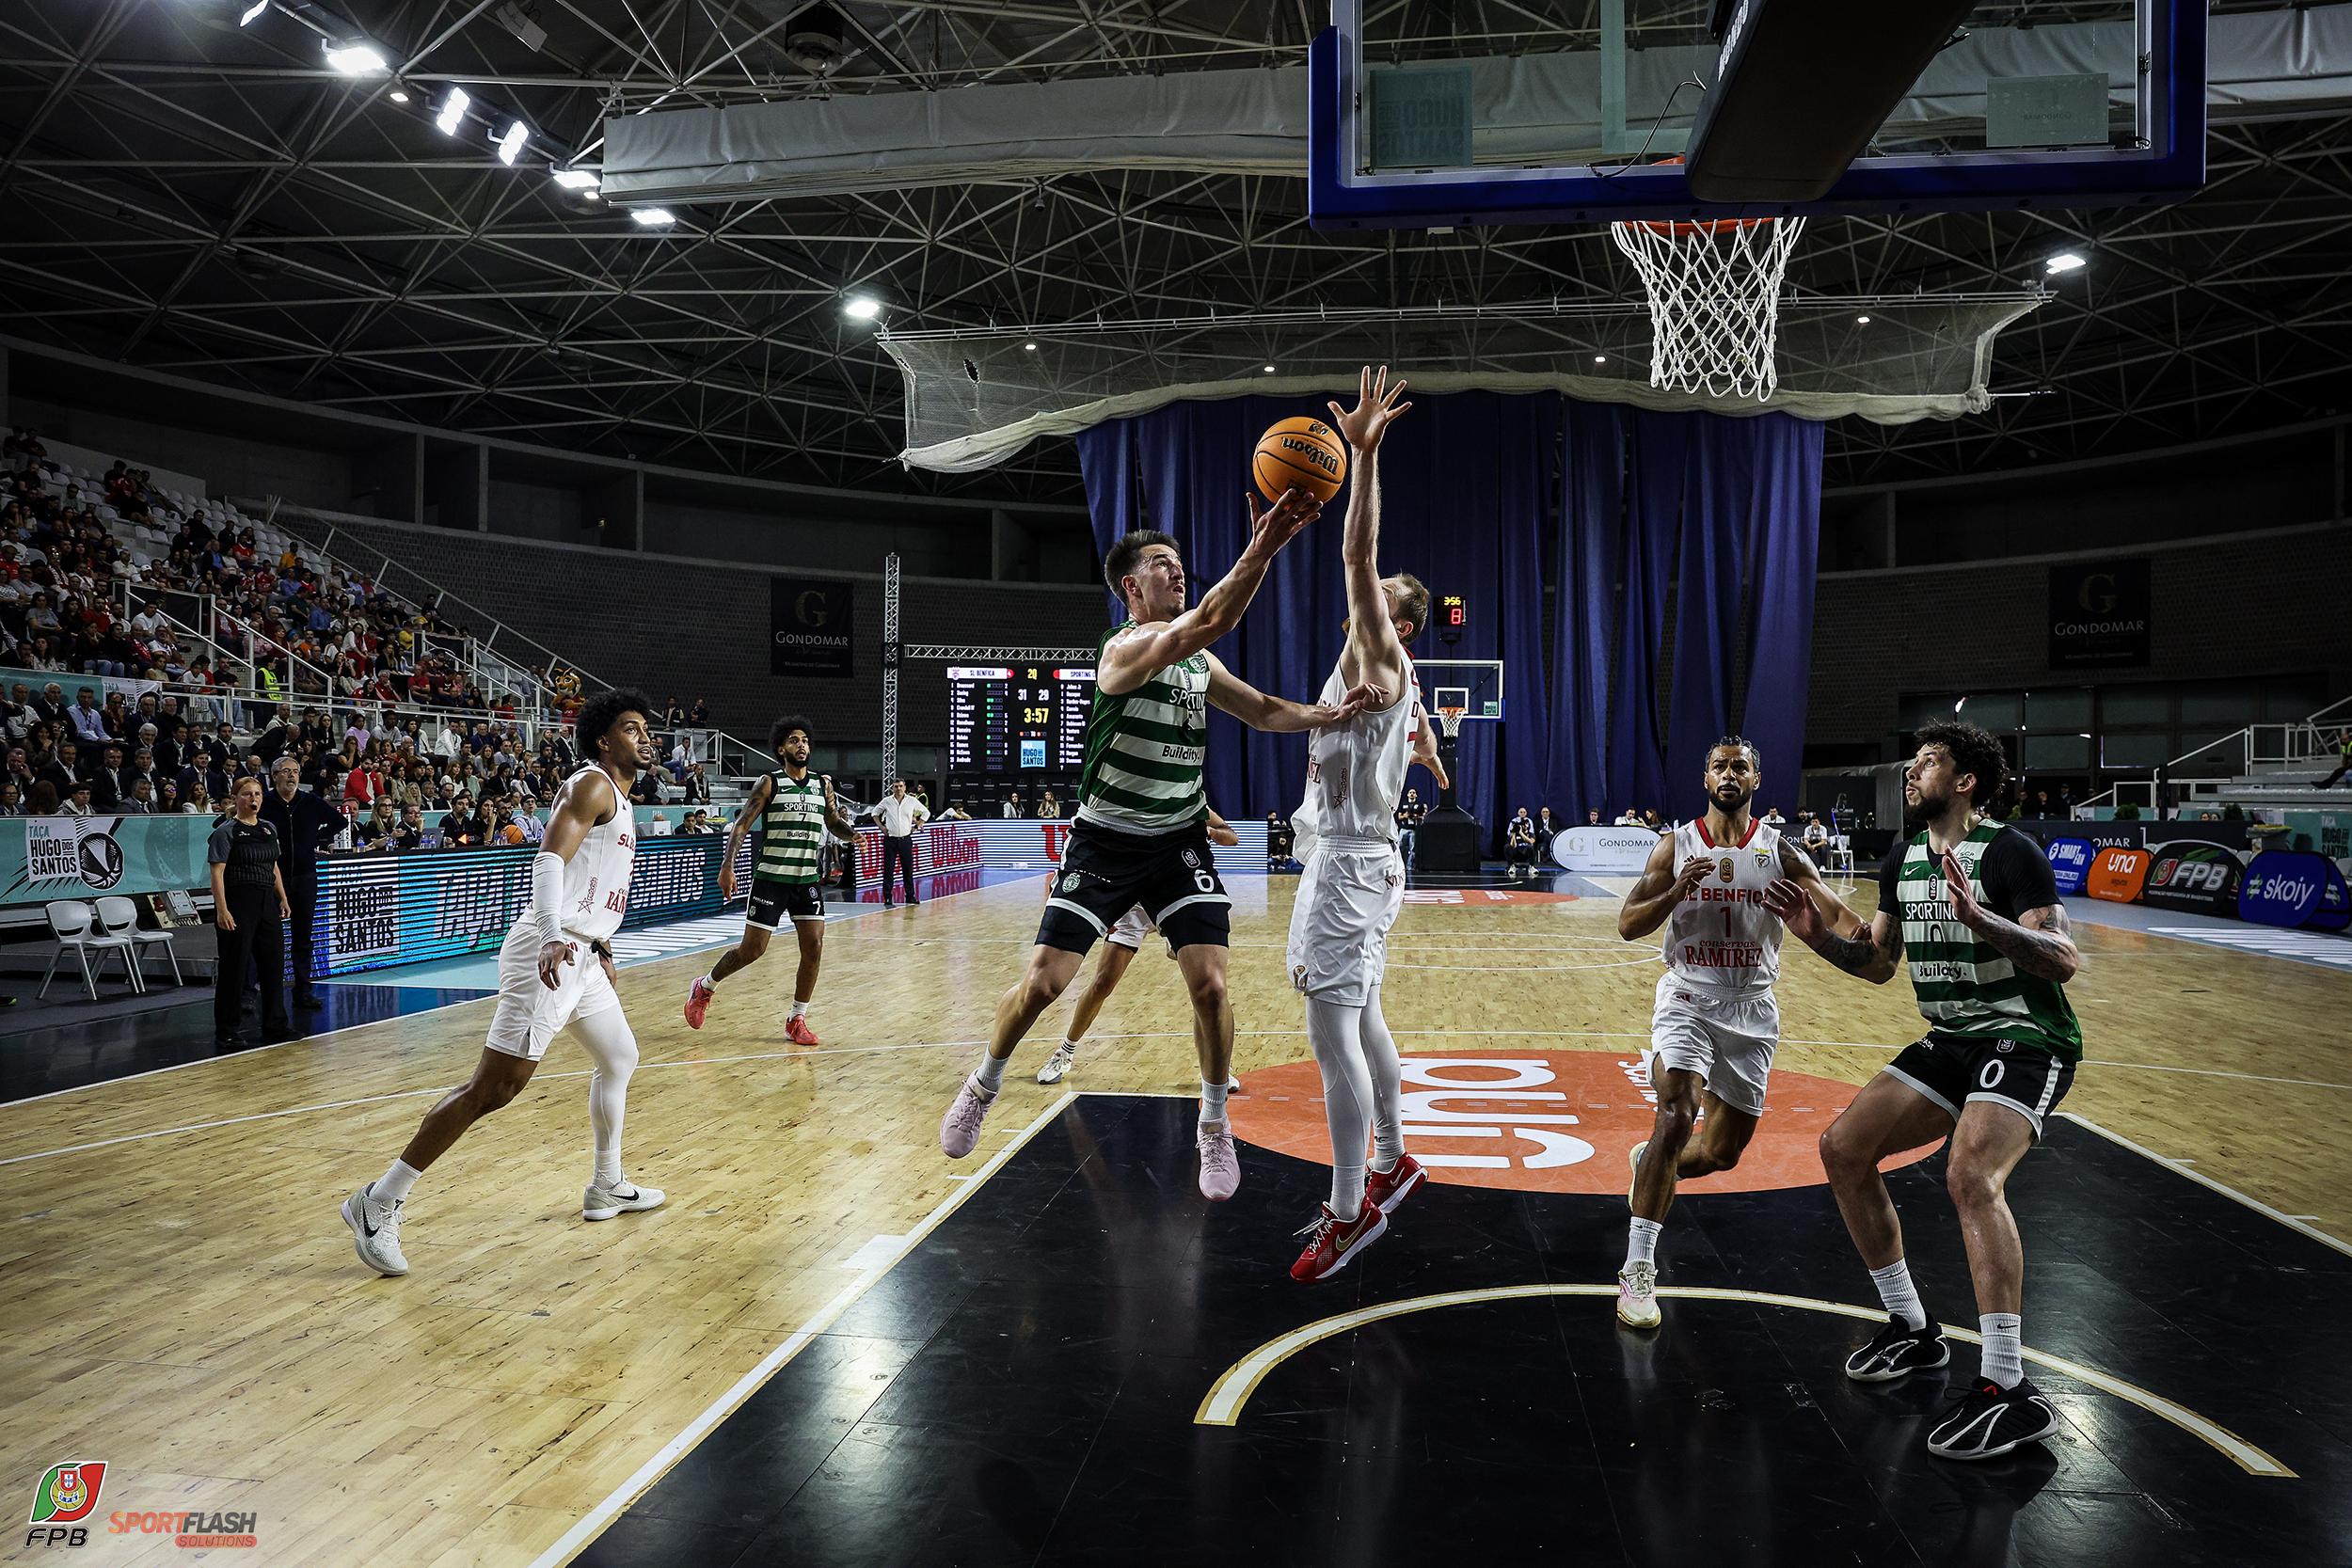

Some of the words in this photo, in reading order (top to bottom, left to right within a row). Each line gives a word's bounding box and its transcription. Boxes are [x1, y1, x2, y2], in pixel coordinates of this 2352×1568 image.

[1281, 436, 1339, 476] Wilson
[1451, 609, 1462, 625] 8
[2055, 620, 2145, 636] GONDOMAR
[775, 631, 849, 647] GONDOMAR
[1018, 689, 1027, 701] 31
[1038, 689, 1050, 701] 29
[1168, 688, 1206, 711] SPTIN
[1024, 707, 1050, 723] 3:57
[784, 802, 818, 813] SPORTING
[798, 813, 807, 823] 7
[29, 825, 50, 838] TAÇA
[30, 838, 61, 858] HUGO
[62, 842, 74, 851] DOS
[1598, 838, 1655, 847] GONDOMAR
[32, 857, 77, 876] SANTOS
[2107, 852, 2137, 874] una
[1194, 868, 1216, 894] 6
[2169, 861, 2229, 892] FPB
[1701, 887, 1765, 905] BENFIC
[2263, 874, 2315, 911] skoiy
[812, 900, 822, 915] 7
[1719, 906, 1732, 939] 1
[1699, 940, 1756, 949] conservas
[1684, 945, 1763, 968] RAMIREZ
[1979, 1058, 2006, 1089] 0
